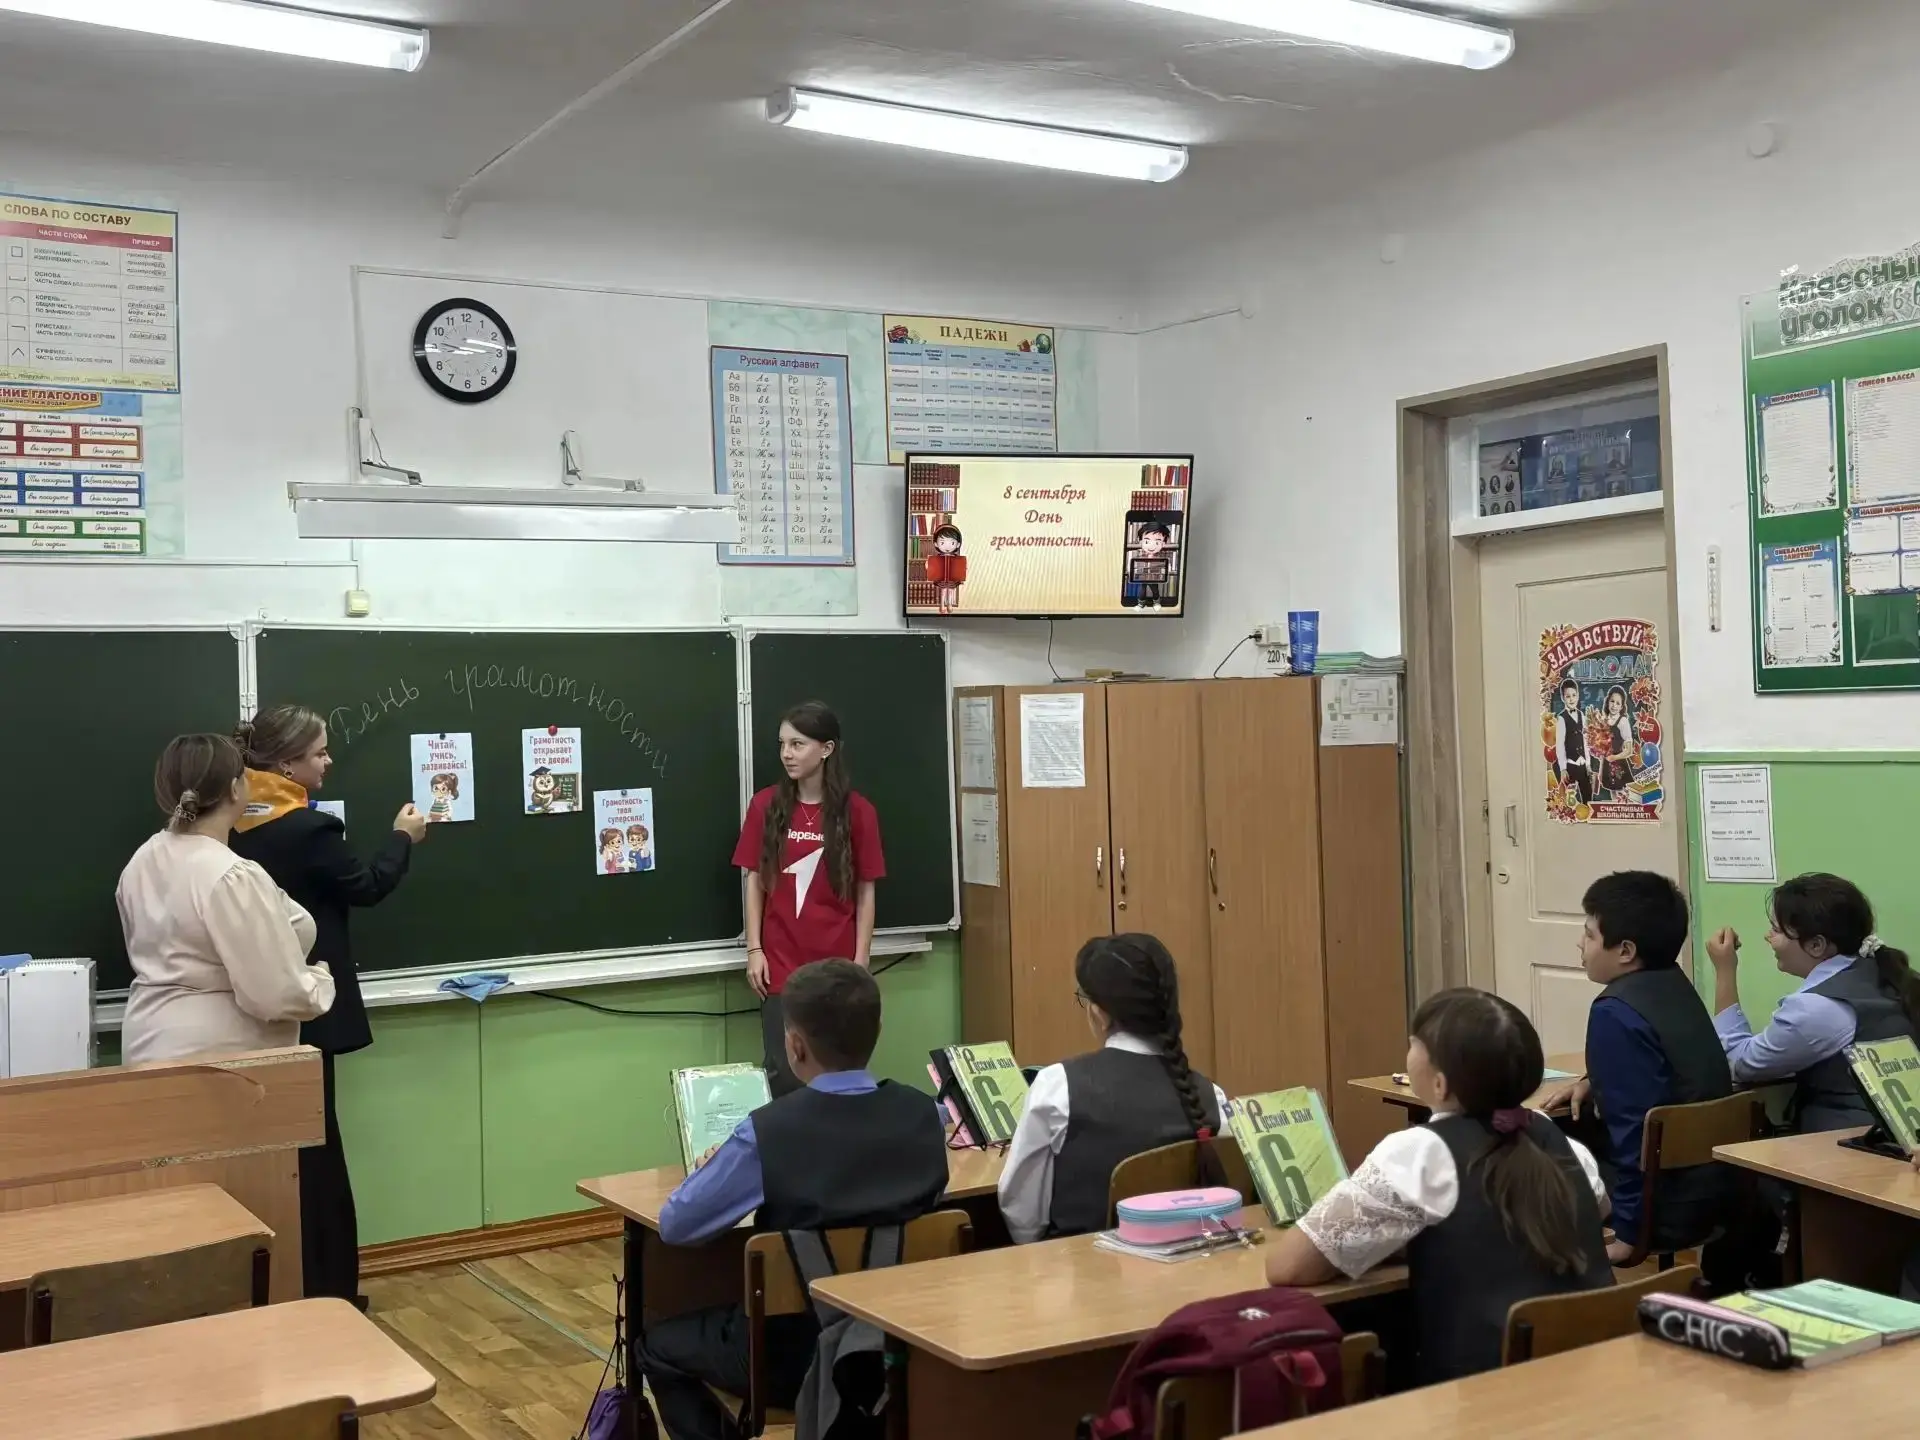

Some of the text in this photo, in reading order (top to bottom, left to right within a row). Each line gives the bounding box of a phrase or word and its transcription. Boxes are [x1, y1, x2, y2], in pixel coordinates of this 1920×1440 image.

[3, 203, 132, 226] СЛОВА ПО СОСТАВУ
[38, 229, 88, 240] ЧАСТИ СЛОВА
[132, 239, 160, 247] ПРИМЕР
[34, 271, 61, 279] ОСНОВА
[1893, 287, 1904, 310] 6
[446, 316, 455, 326] 11
[461, 313, 472, 323] 12
[480, 320, 485, 329] 1
[433, 327, 445, 337] 10
[490, 332, 498, 341] 2
[940, 326, 1009, 342] ПАДЕЖИ
[495, 349, 503, 358] 3
[436, 361, 443, 371] 8
[739, 355, 821, 370] Русский алфавит
[491, 366, 498, 375] 4
[447, 373, 455, 383] 7
[480, 376, 488, 386] 5
[729, 372, 741, 381] Аа
[464, 380, 471, 389] 6
[32, 390, 98, 402] ГЛАГОЛОВ
[729, 448, 745, 458] Жж
[1003, 484, 1087, 502] 8 сентября
[1024, 509, 1063, 524] День
[990, 534, 1095, 551] грамотности.
[735, 545, 748, 555] Пп
[1547, 624, 1644, 670] ЗДРАВСТВУЙ,
[1267, 650, 1280, 663] 220
[328, 676, 421, 744] День
[427, 739, 457, 751] Читай,
[529, 736, 576, 747] Грамотность
[429, 752, 457, 762] учись,
[533, 747, 572, 756] открывает
[421, 760, 468, 772] развивайся!
[547, 755, 573, 766] двери!
[602, 798, 643, 808] Грамотность
[1600, 805, 1645, 813] СЧАСТЛИВЫХ
[607, 813, 645, 824] суперсила!
[1596, 811, 1651, 820] ШКОЛЬНЫХ ЛЕТ!
[1867, 1047, 1904, 1078] Русский
[972, 1075, 1019, 1141] 6
[1245, 1098, 1315, 1134] Русский язык
[1257, 1133, 1313, 1221] 6
[1658, 1310, 1744, 1357] CHIC
